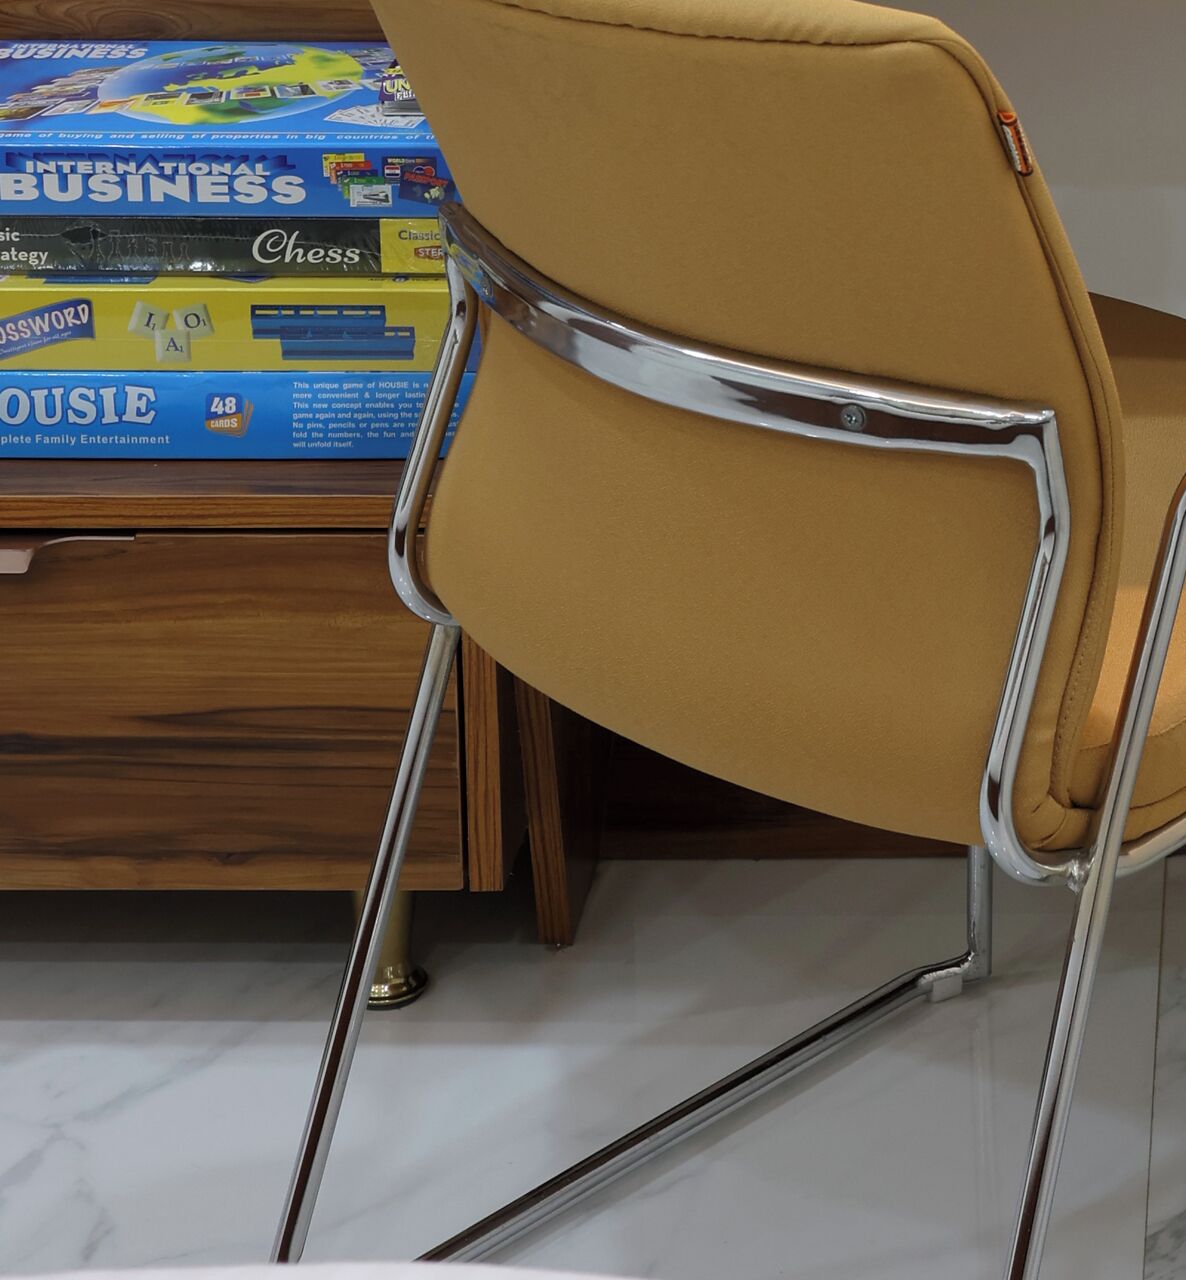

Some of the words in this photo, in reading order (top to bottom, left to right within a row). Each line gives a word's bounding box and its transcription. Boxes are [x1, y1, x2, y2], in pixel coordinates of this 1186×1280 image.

[0, 48, 148, 59] BUSINESS
[59, 132, 103, 140] buying
[141, 132, 185, 140] selling
[25, 160, 271, 176] INTERNATIONAL
[0, 173, 306, 205] BUSINESS
[398, 230, 441, 240] Classic
[252, 228, 360, 264] Chess
[0, 247, 48, 265] ategy
[313, 382, 339, 390] unique
[376, 392, 400, 400] longer
[0, 385, 157, 425] OUSIE
[210, 397, 236, 415] 48
[331, 402, 362, 410] concept
[210, 418, 238, 428] CARDS
[328, 421, 355, 429] pencils
[1, 434, 31, 445] plete
[35, 434, 76, 446] Family
[80, 434, 170, 444] Entertainment
